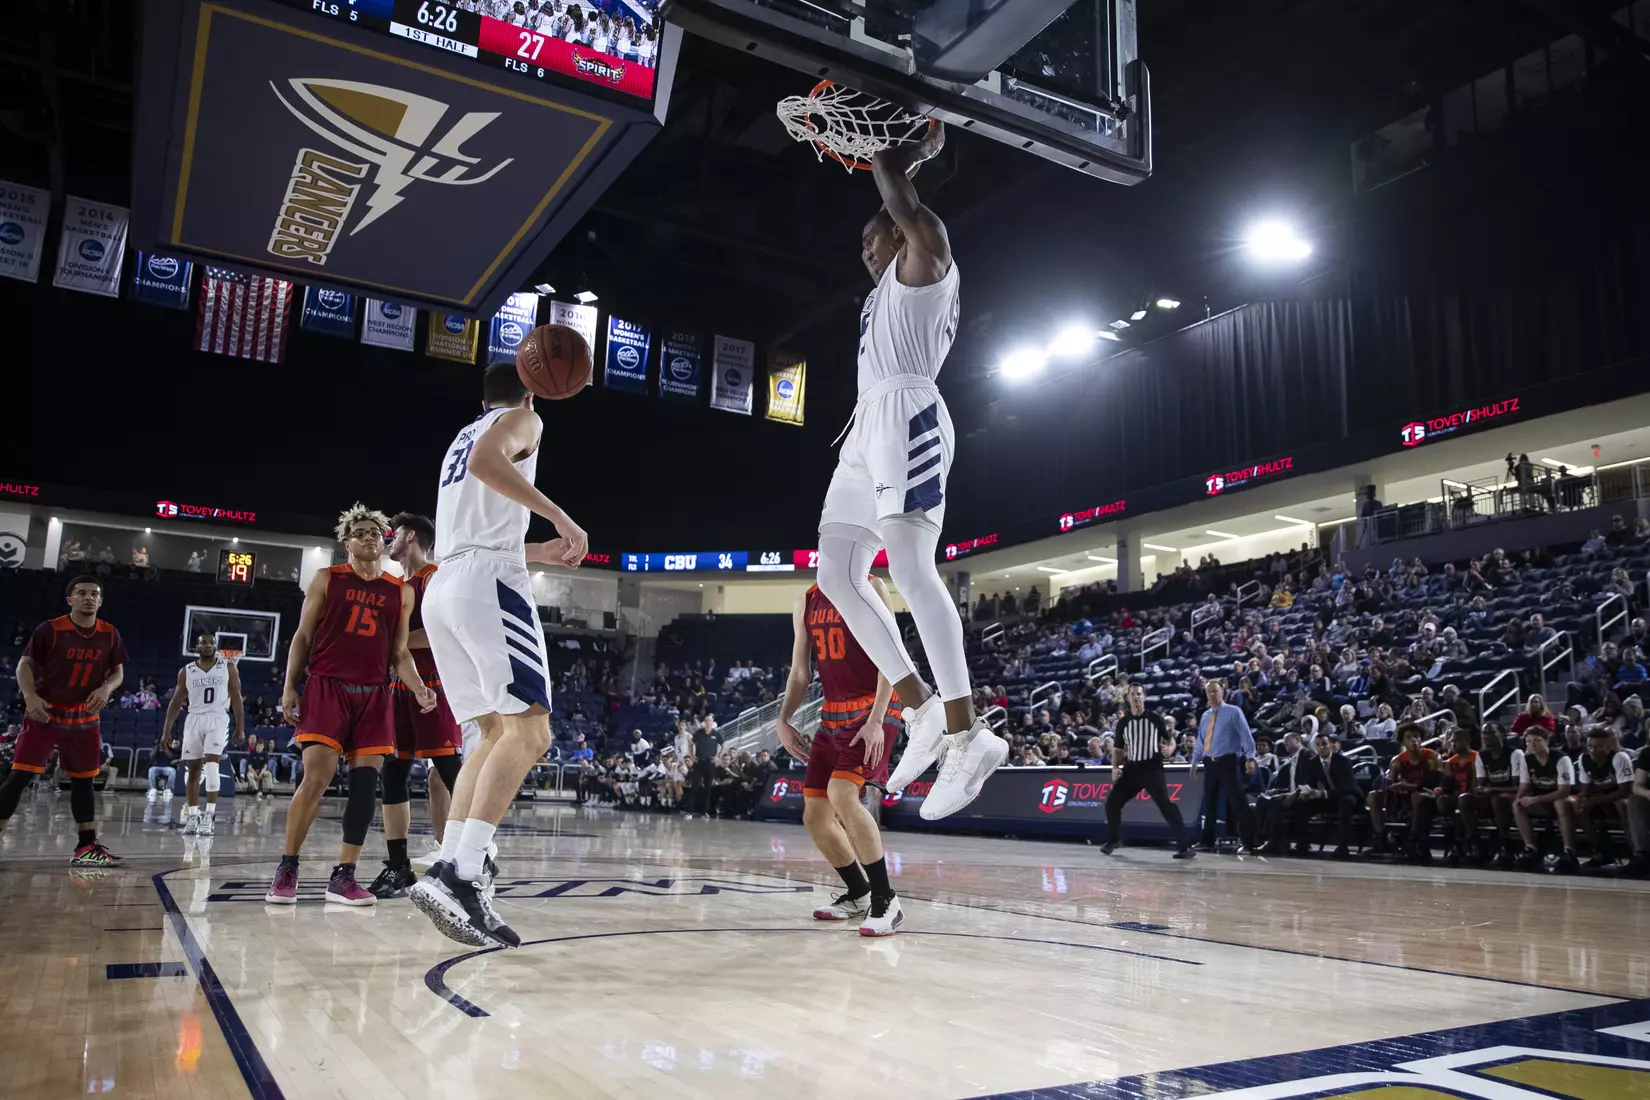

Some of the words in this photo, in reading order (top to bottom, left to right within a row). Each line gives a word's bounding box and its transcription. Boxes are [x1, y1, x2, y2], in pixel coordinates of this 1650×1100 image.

[312, 0, 339, 16] FLS
[349, 10, 358, 22] 5
[416, 1, 458, 33] 6:26
[405, 27, 429, 42] 1ST
[436, 35, 469, 53] HALF
[517, 31, 546, 61] 27
[505, 58, 528, 74] FLS
[537, 68, 545, 78] 6
[577, 59, 620, 83] SPIRIT
[78, 206, 115, 222] 2014
[267, 148, 370, 265] LANCERS
[64, 225, 122, 242] BASKETBALL
[80, 219, 110, 232] MEN'S
[59, 267, 117, 283] TOURNAMENT
[67, 261, 105, 274] DIVISION
[134, 277, 187, 294] CHAMPIONS
[305, 307, 353, 323] CHAMPIONS
[494, 311, 534, 325] ASKETBALL
[501, 305, 529, 317] OMEN'S
[367, 319, 386, 328] WEST
[386, 322, 412, 333] REGION
[368, 326, 410, 339] CHAMPIONS
[445, 319, 465, 330] NCAA
[617, 319, 643, 333] 2017
[432, 333, 467, 345] DIVISION
[609, 335, 649, 348] BASKETBALL
[612, 328, 645, 341] WOMEN'S
[671, 331, 695, 343] 2017
[431, 339, 469, 351] NATIONAL
[722, 342, 746, 354] 2017
[607, 368, 646, 380] CHAMPIONS
[1426, 398, 1520, 431] TOVEY/SHULTZ
[442, 440, 474, 488] 33
[1224, 456, 1293, 483] TOVEY/SHULTZ
[179, 503, 256, 522] TOVEY/SHULTZ
[228, 552, 252, 566] 6:26
[664, 554, 697, 571] CBU
[718, 553, 733, 569] 34
[760, 551, 781, 565] 6:26
[231, 564, 248, 582] 19
[345, 589, 387, 607] OUAZ
[345, 604, 380, 637] 15
[811, 628, 847, 660] 30
[66, 648, 102, 661] OUAZ
[68, 662, 93, 688] 11
[203, 687, 215, 704] 0
[1042, 785, 1069, 806] TS
